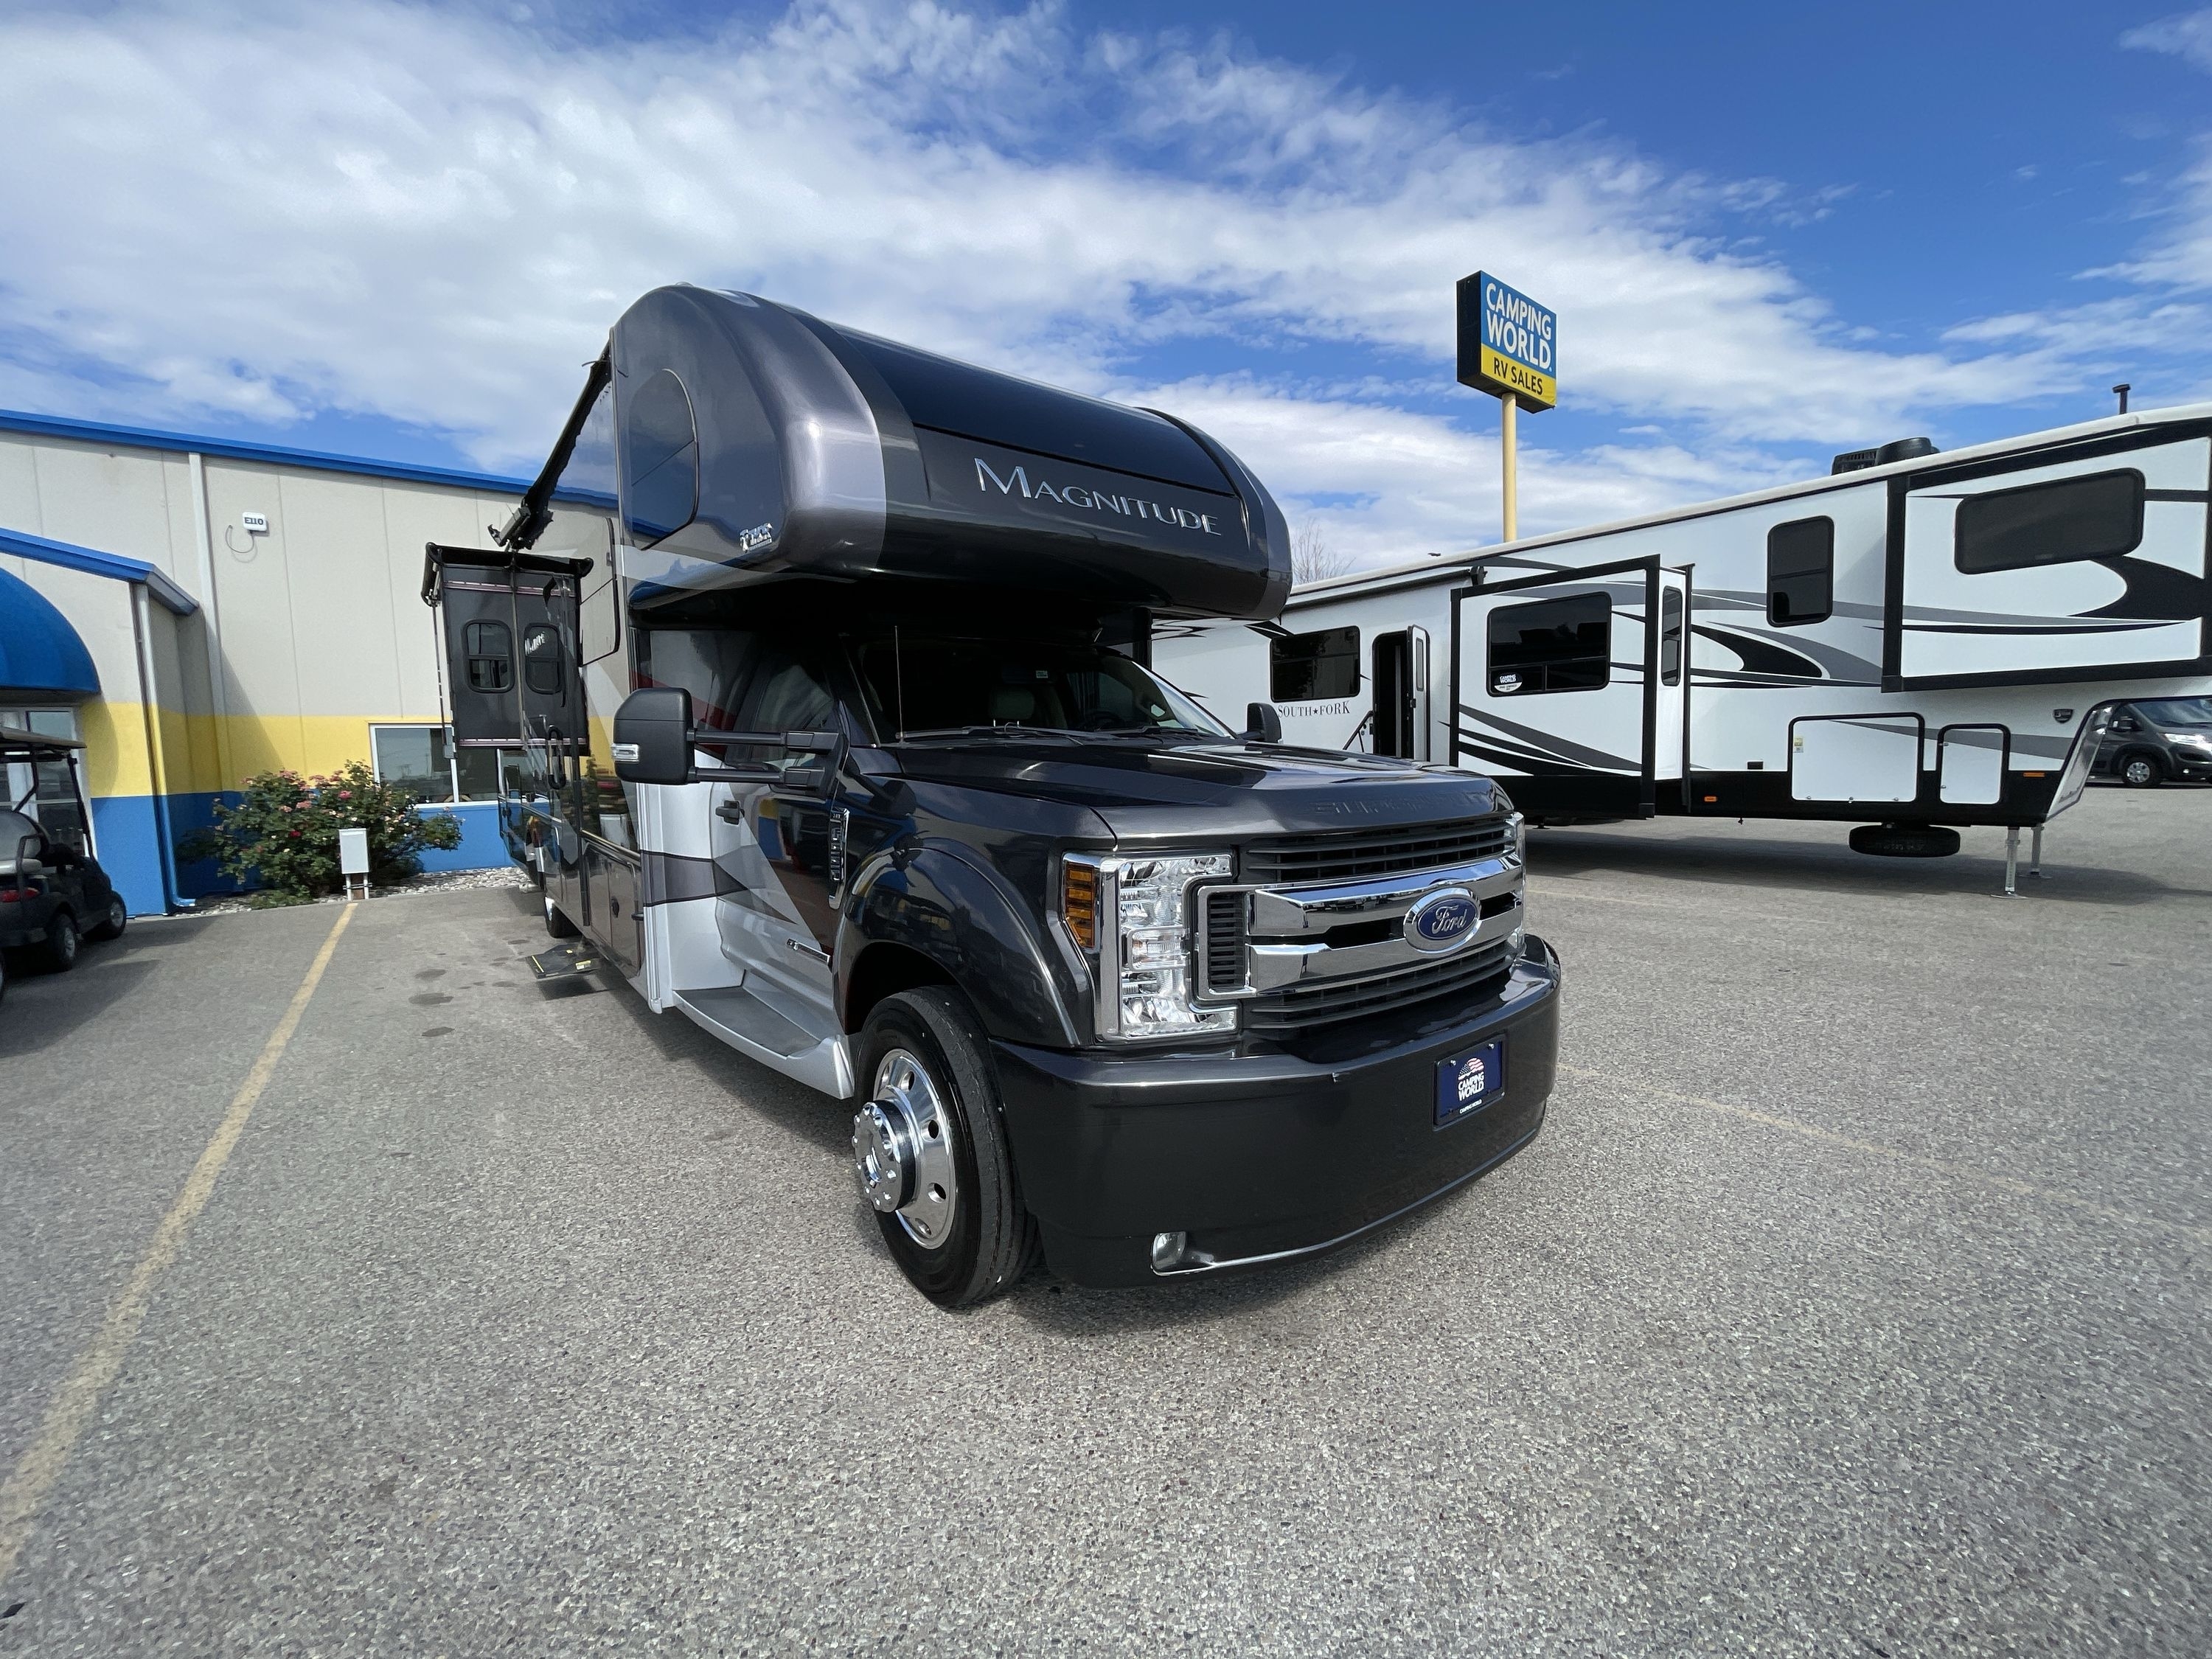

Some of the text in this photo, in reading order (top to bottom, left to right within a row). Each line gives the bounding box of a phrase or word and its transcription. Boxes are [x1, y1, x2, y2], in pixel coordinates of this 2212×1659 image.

[1486, 282, 1551, 341] CAMPING
[1486, 309, 1551, 369] WORLD
[1494, 357, 1543, 395] RV SALES
[1320, 700, 1351, 715] FORK
[1431, 904, 1468, 934] Ford
[1458, 1071, 1484, 1091] CAMPING
[1458, 1080, 1484, 1101] WORLD
